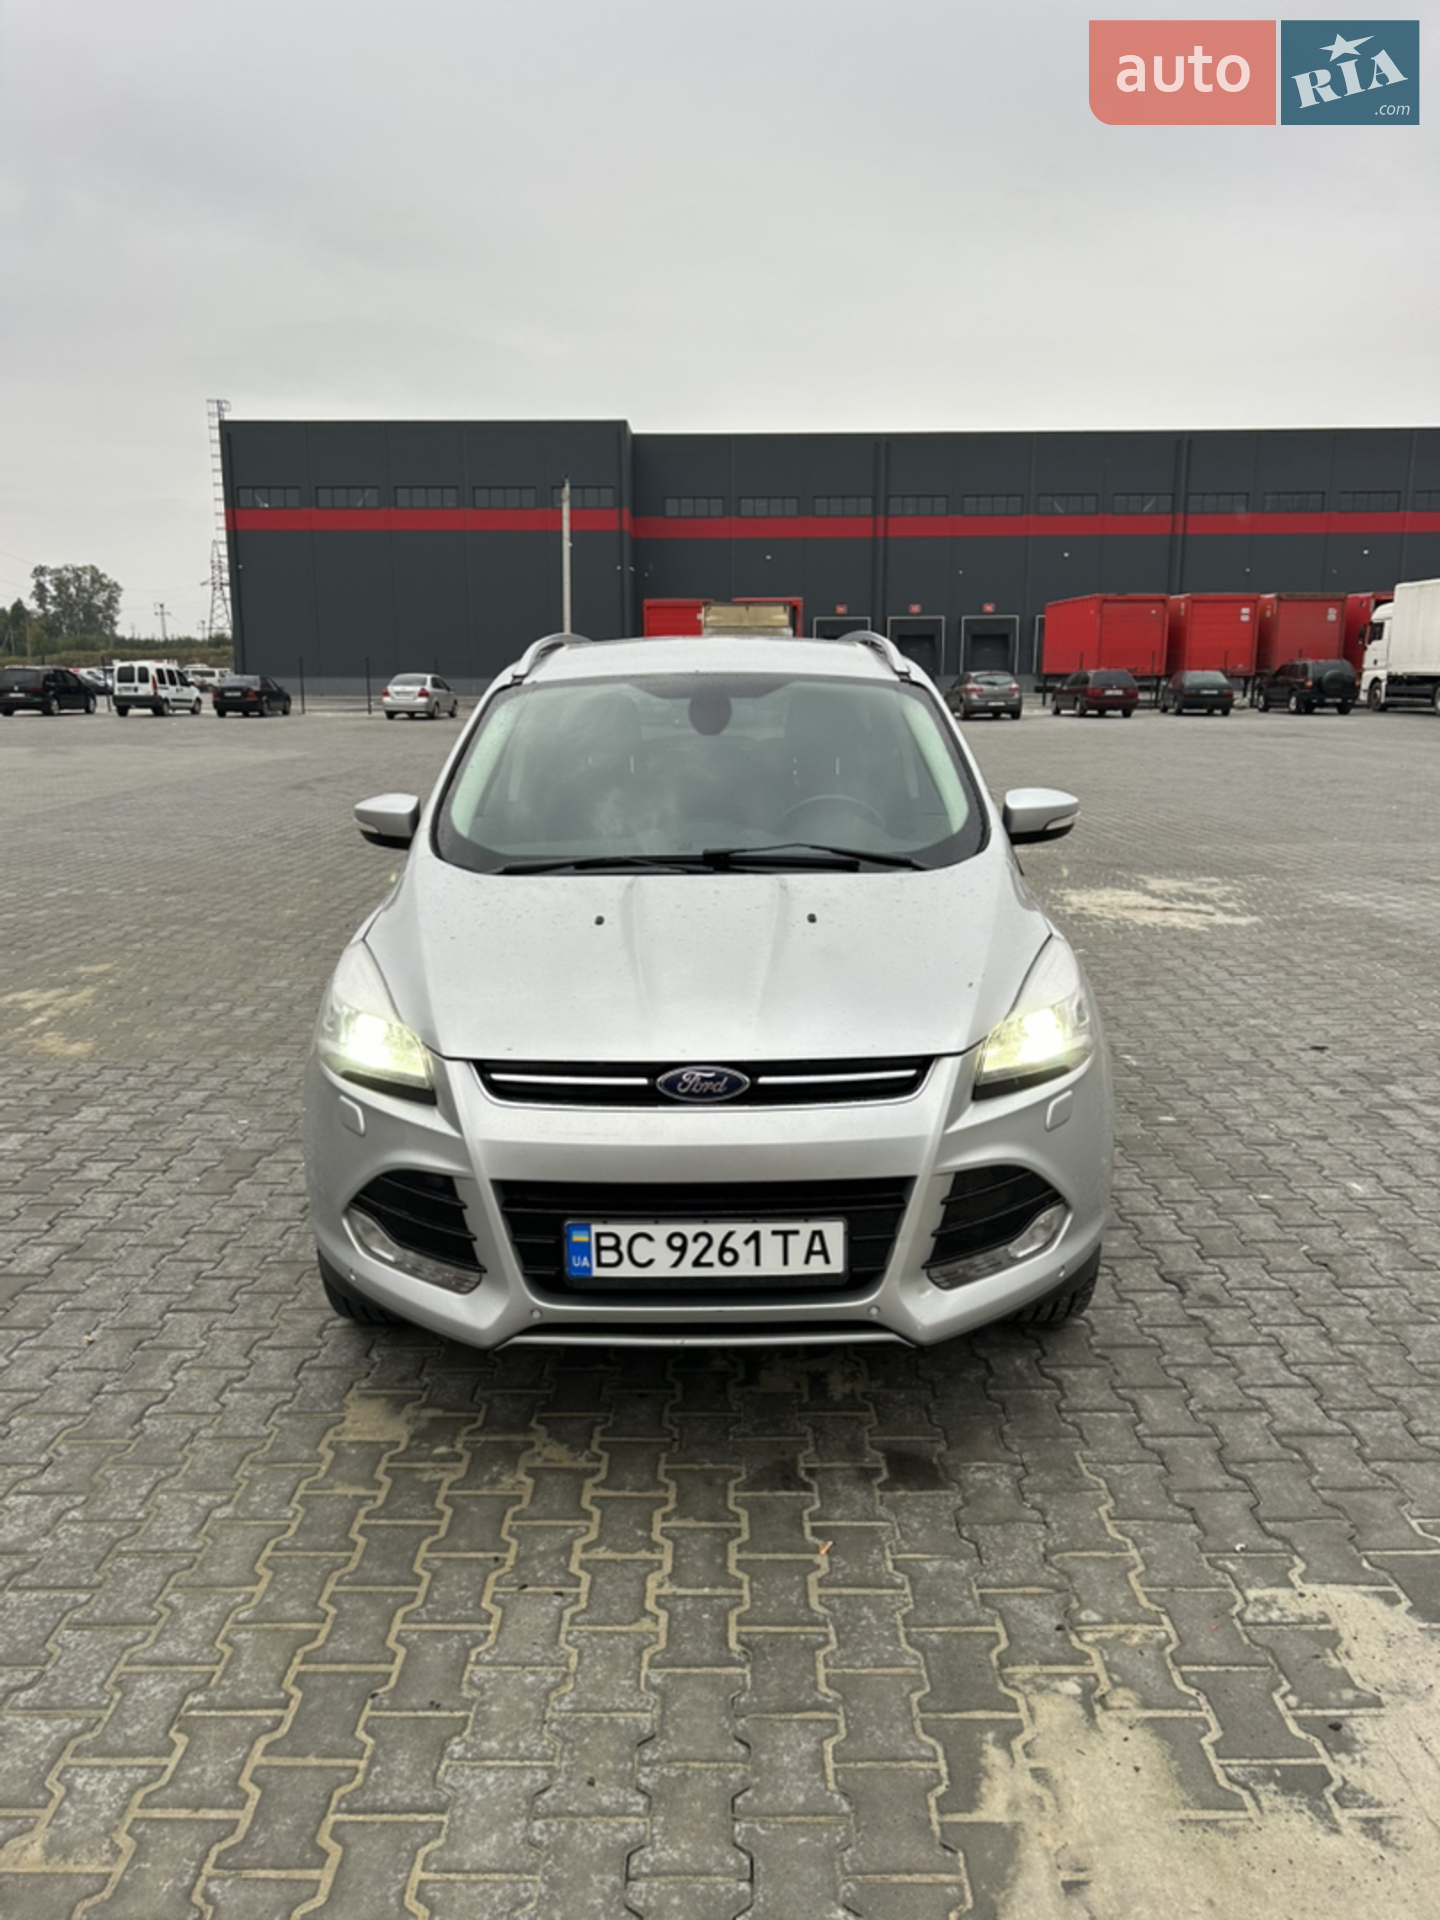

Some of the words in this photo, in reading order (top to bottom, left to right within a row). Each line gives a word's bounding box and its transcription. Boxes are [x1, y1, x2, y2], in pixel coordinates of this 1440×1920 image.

[677, 1071, 728, 1093] Ford
[595, 1231, 655, 1268] BC
[572, 1255, 590, 1267] UA
